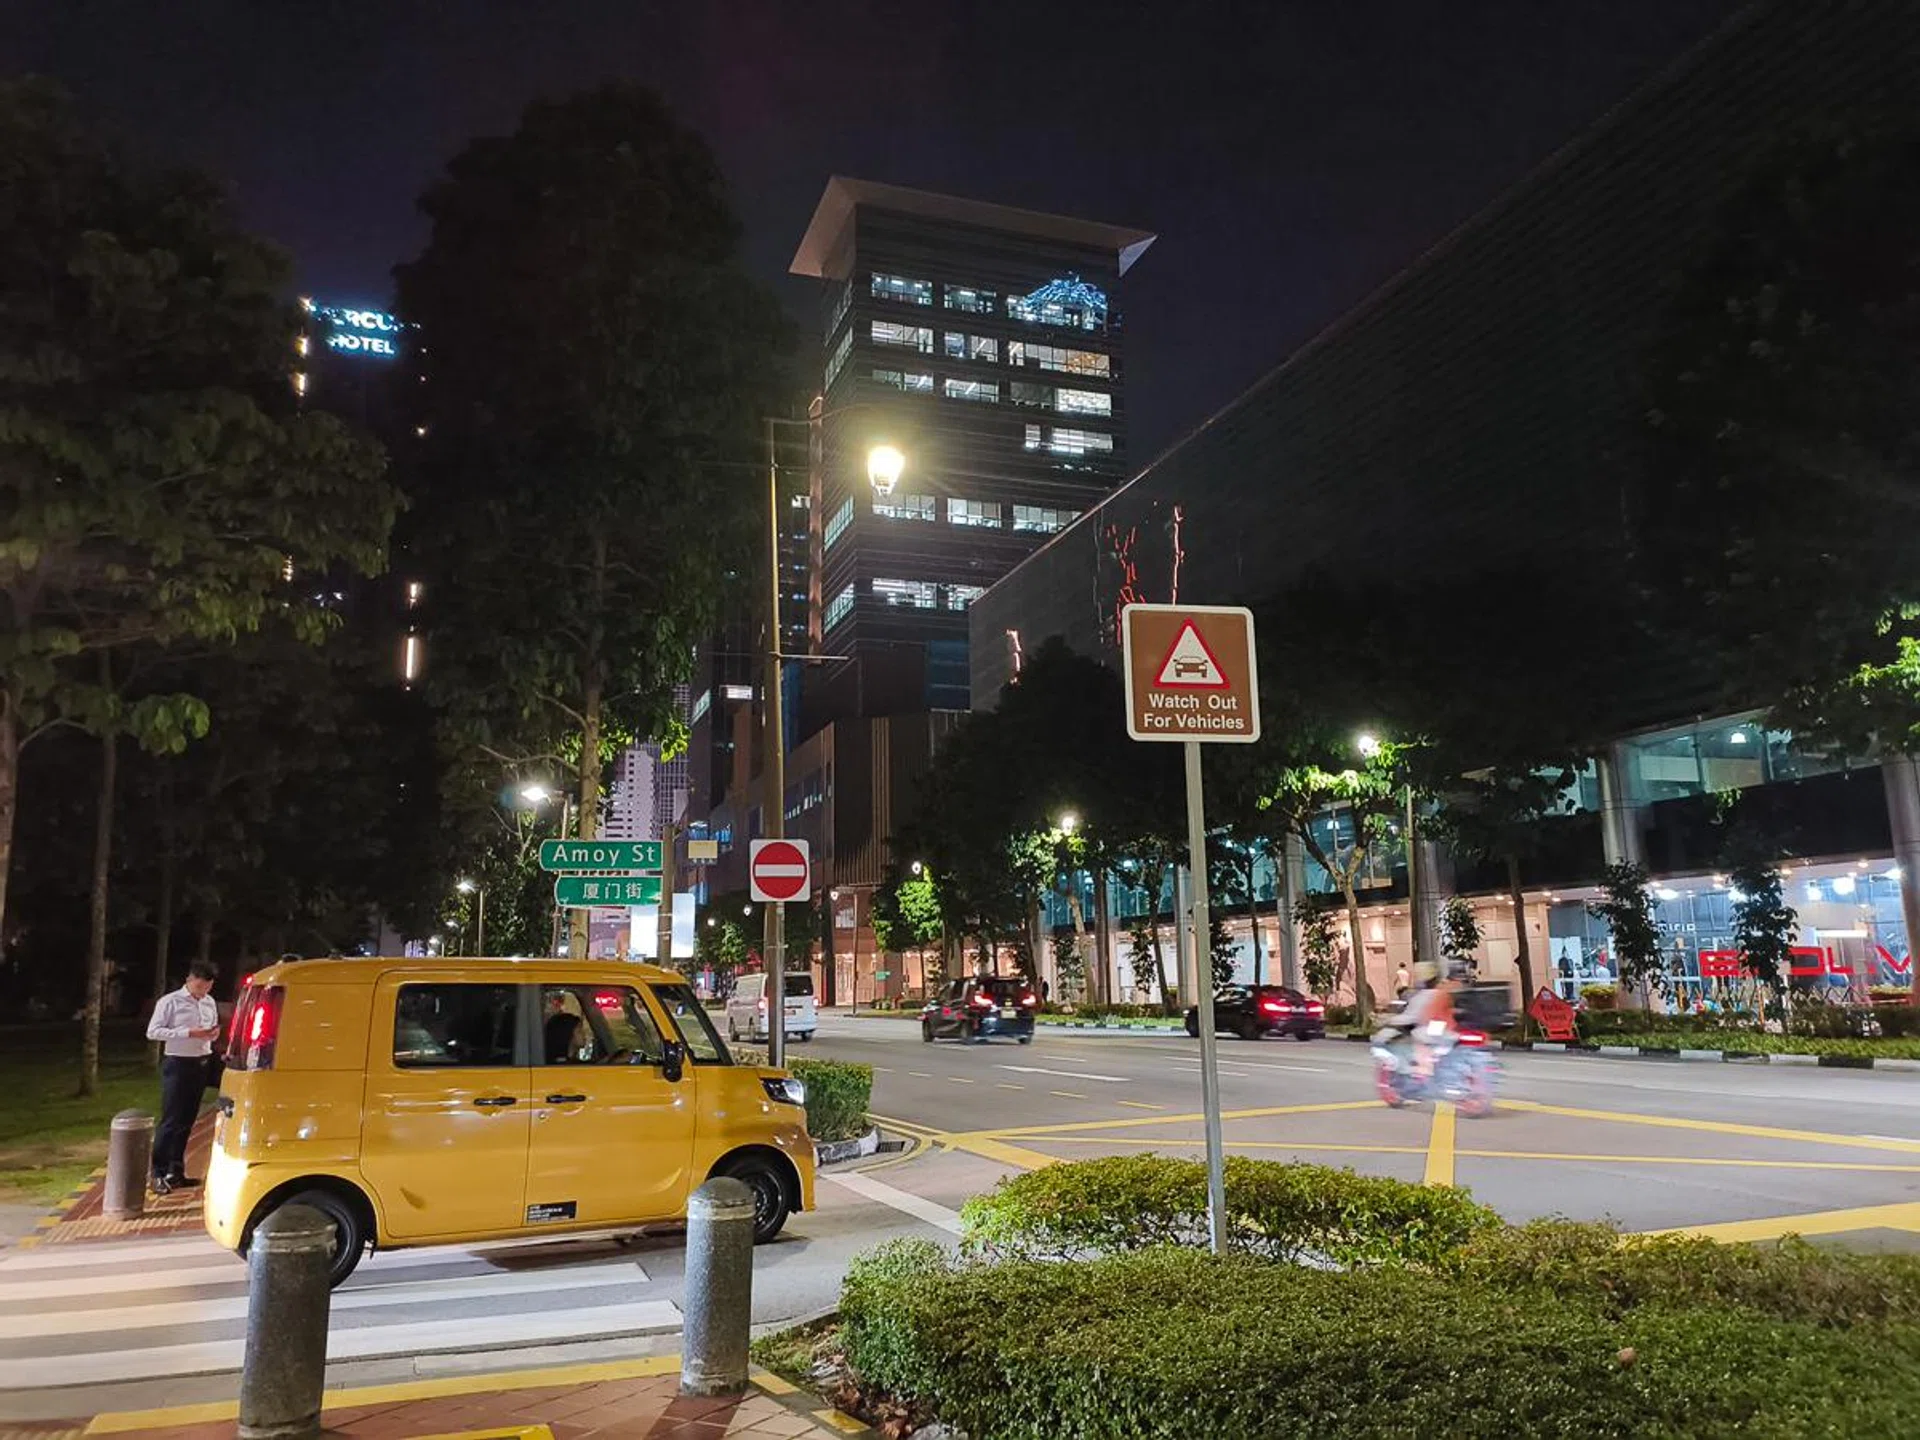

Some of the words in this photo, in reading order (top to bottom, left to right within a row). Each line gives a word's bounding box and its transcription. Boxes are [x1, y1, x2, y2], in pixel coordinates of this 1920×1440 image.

[326, 334, 395, 355] HOTEL
[1148, 692, 1200, 709] Watch
[1207, 694, 1238, 710] Out
[1143, 713, 1173, 728] For
[1175, 713, 1245, 729] Vehicles
[552, 844, 621, 866] Amoy
[632, 844, 656, 863] St
[582, 882, 644, 900] 厦门街
